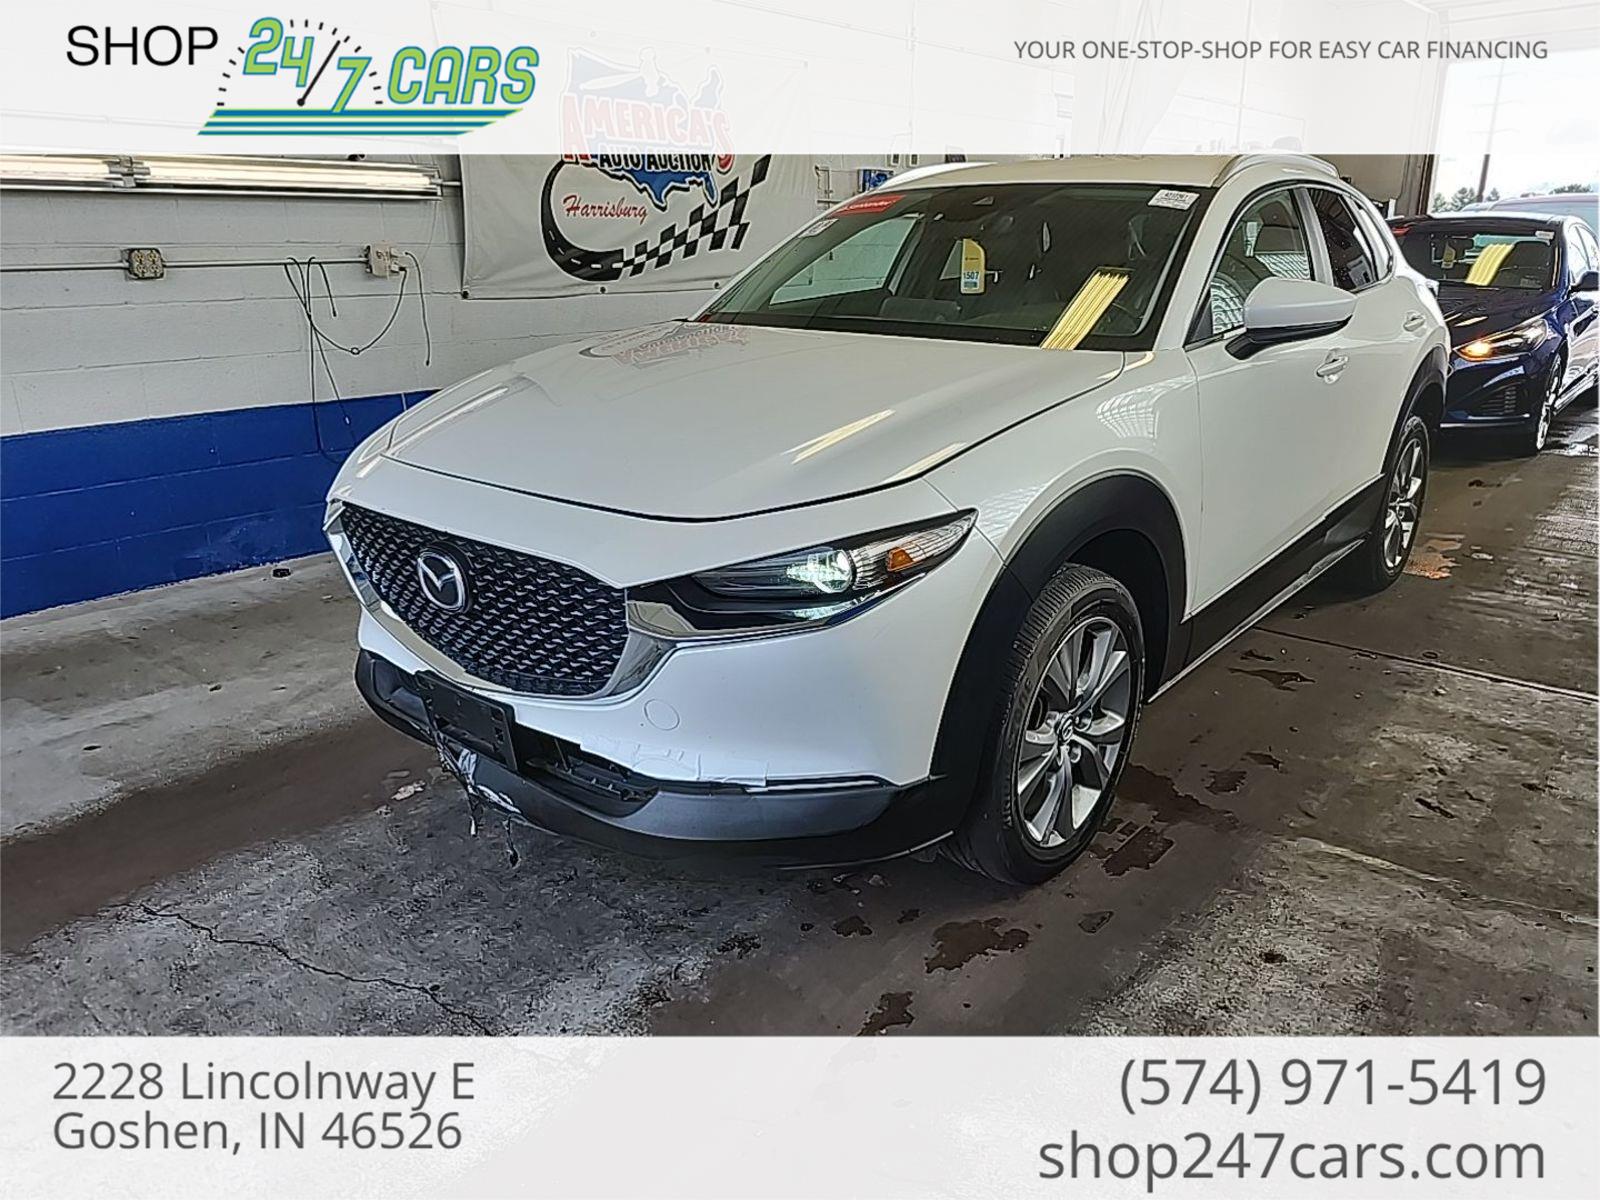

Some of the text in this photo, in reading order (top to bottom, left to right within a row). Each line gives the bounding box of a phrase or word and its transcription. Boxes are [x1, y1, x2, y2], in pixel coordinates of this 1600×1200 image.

[599, 146, 712, 171] AUTO AUCTION
[563, 195, 648, 225] Harrisburg
